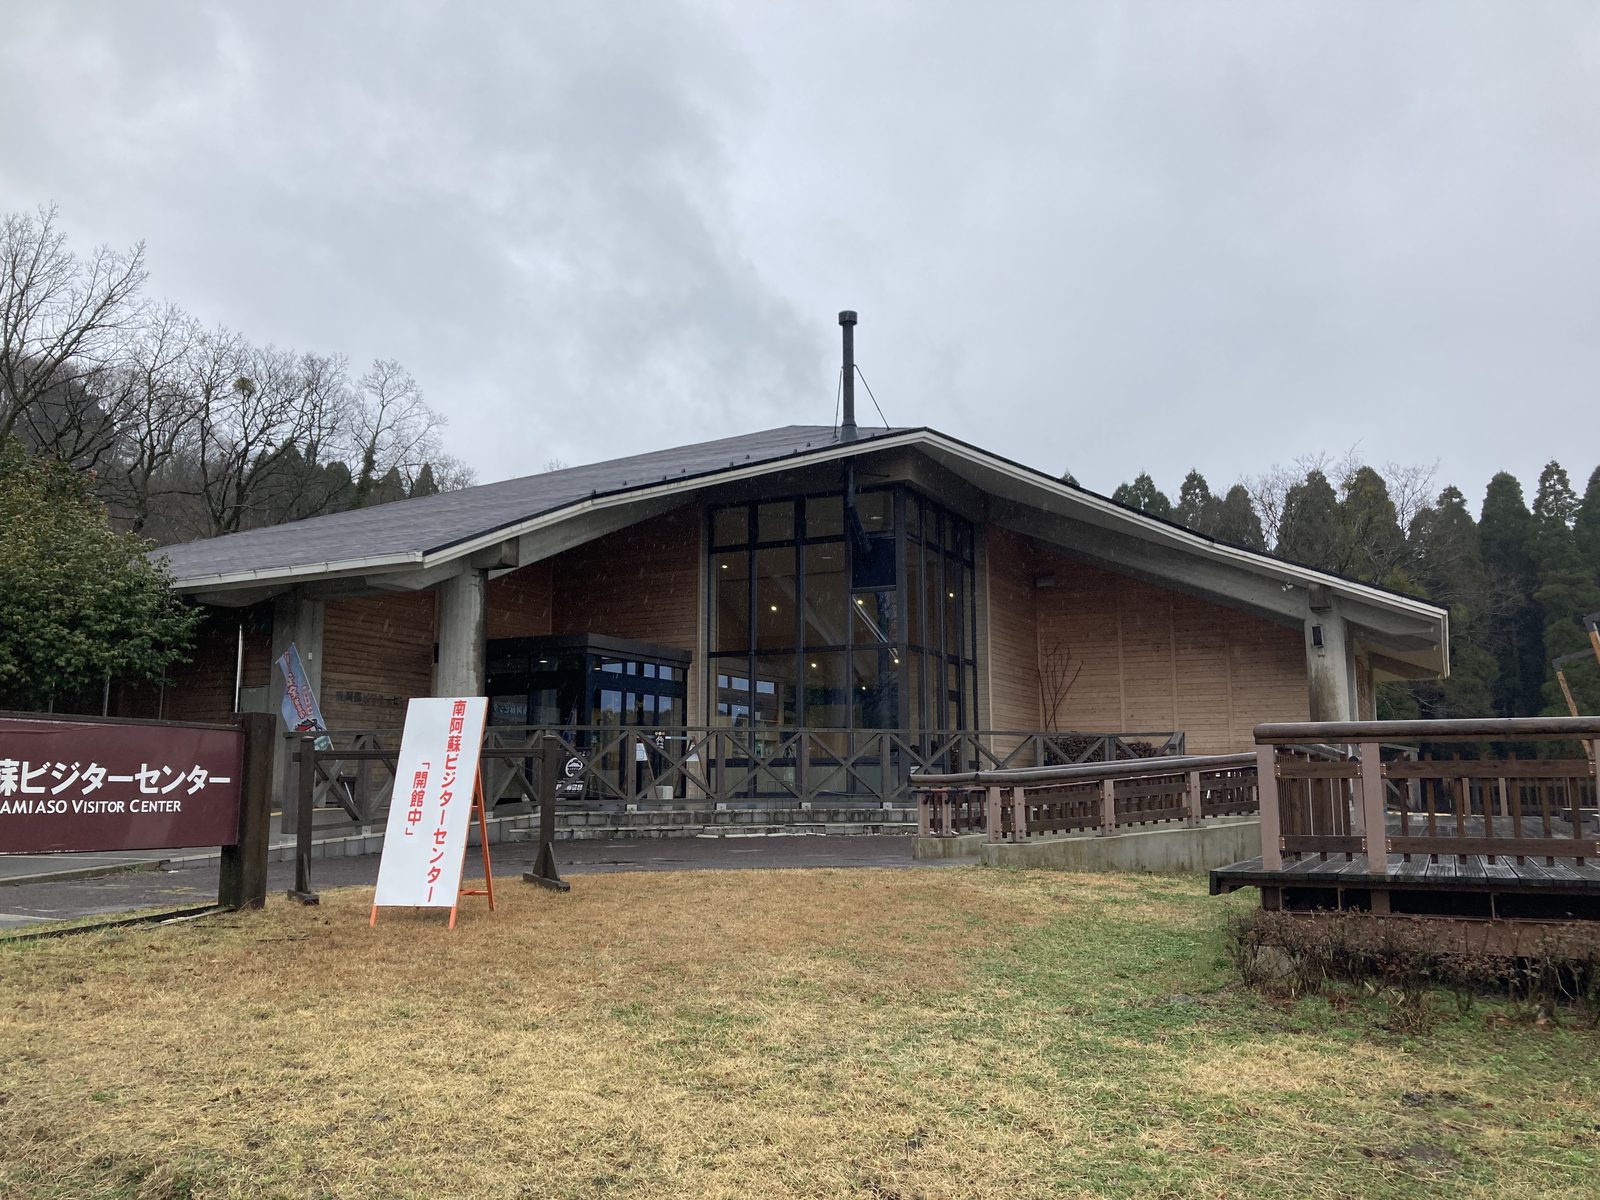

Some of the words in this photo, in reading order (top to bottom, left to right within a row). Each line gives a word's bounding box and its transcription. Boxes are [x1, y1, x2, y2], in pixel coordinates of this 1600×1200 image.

[72, 800, 125, 813] VISITOR
[130, 799, 181, 813] CENTER
[405, 761, 430, 836] 「開館中」
[427, 700, 467, 902] 南阿蘇ビジターセンター
